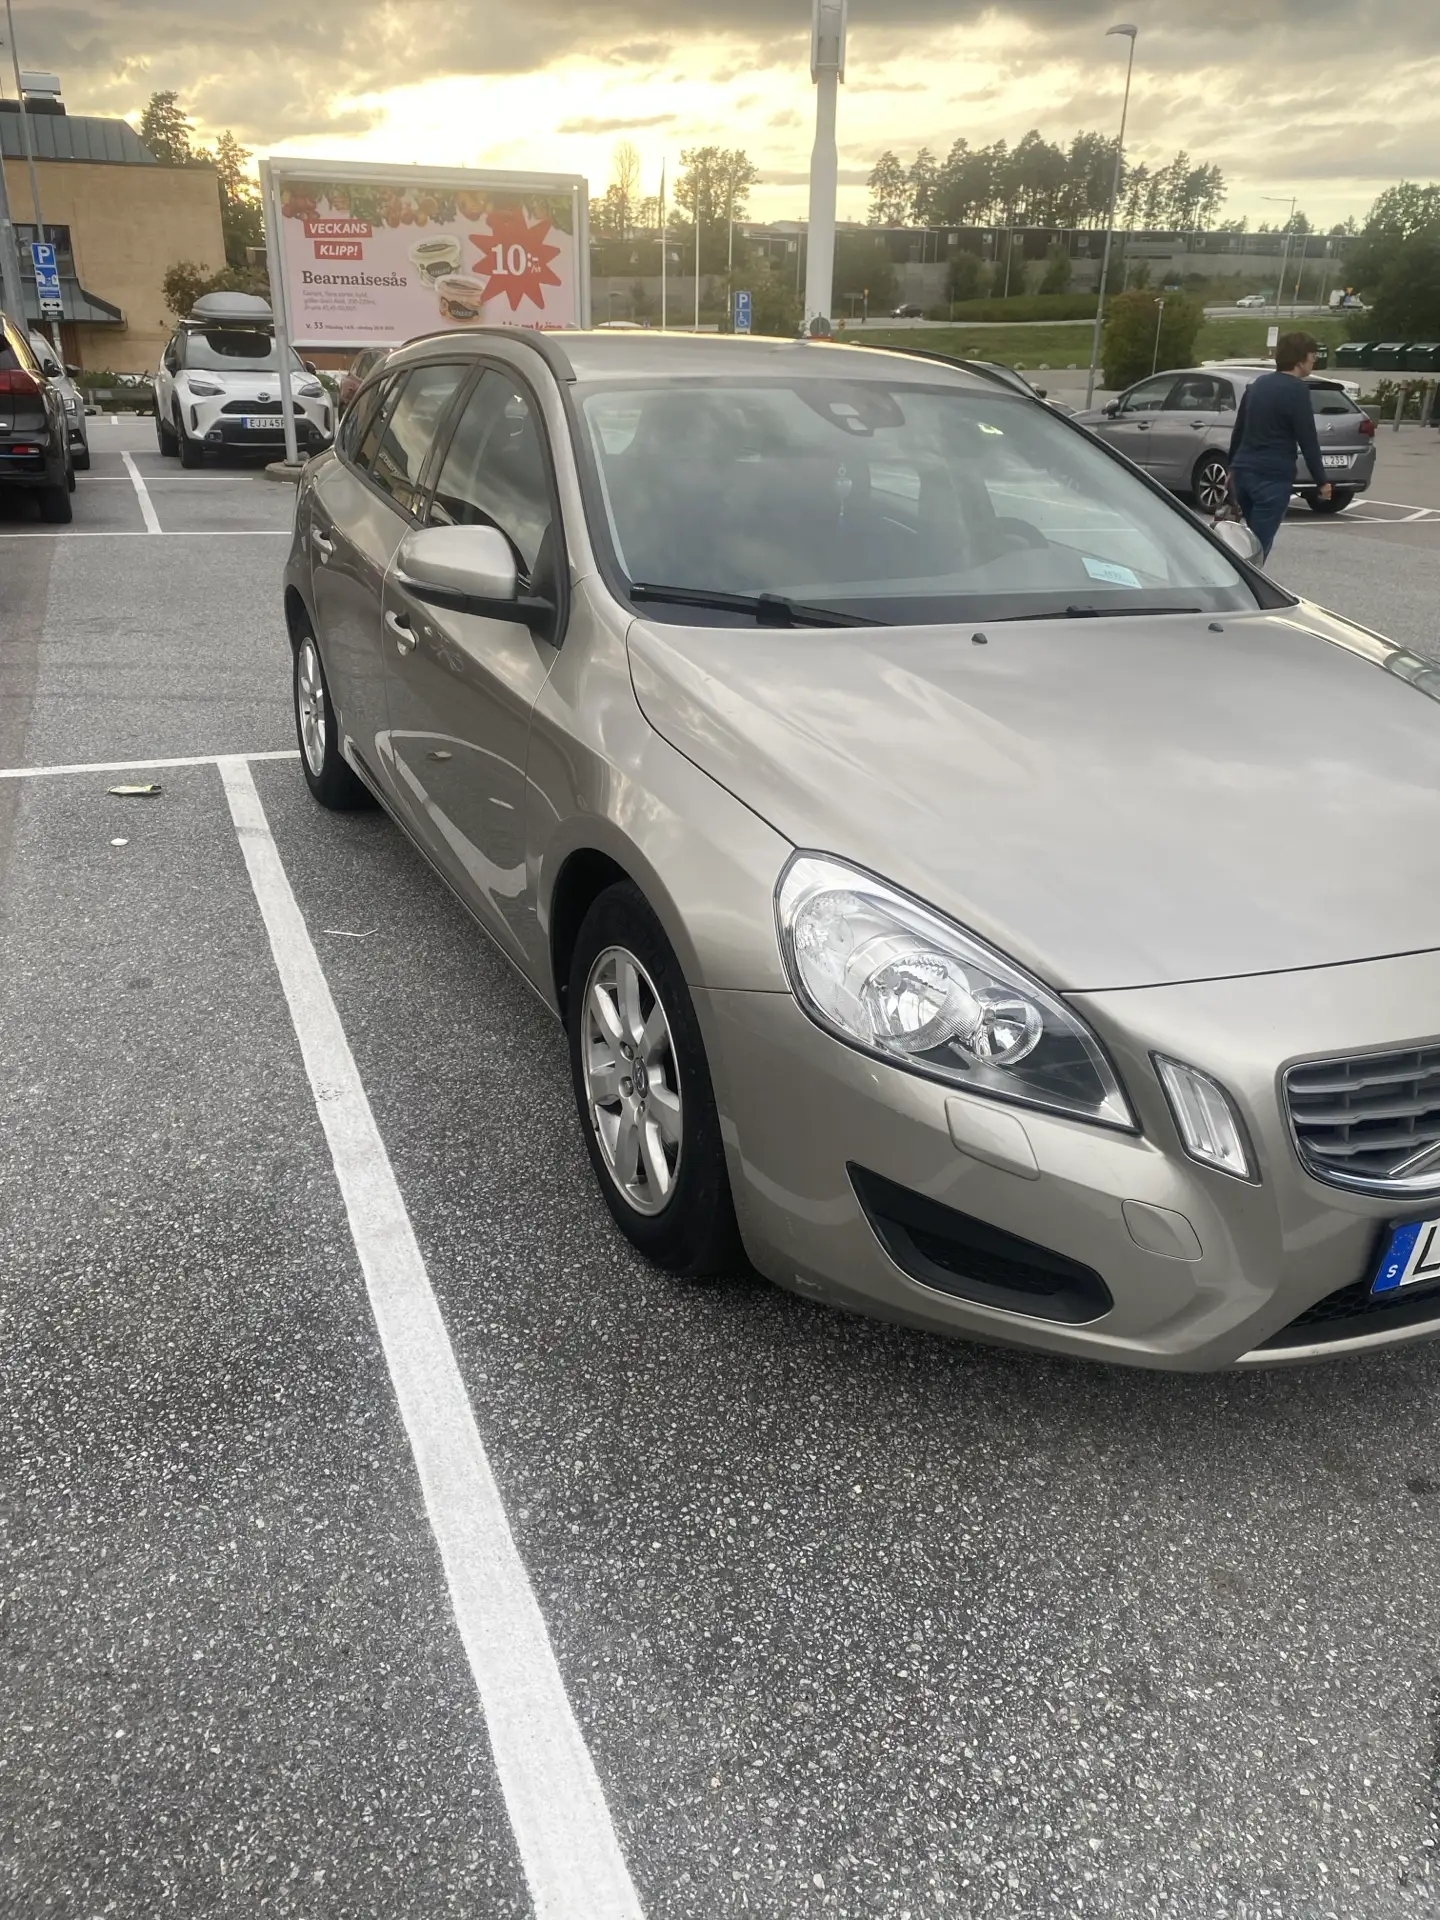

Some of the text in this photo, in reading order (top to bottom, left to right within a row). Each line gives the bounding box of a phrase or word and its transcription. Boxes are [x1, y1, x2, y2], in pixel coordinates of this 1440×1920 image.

[309, 223, 367, 234] VECKANS
[37, 246, 50, 264] P
[320, 244, 358, 256] KLIPP!
[302, 270, 407, 287] Bearnaisesås
[739, 293, 748, 308] P
[314, 321, 323, 329] 33
[250, 419, 267, 428] EJJ
[1331, 455, 1345, 464] 235
[1386, 1264, 1399, 1279] S
